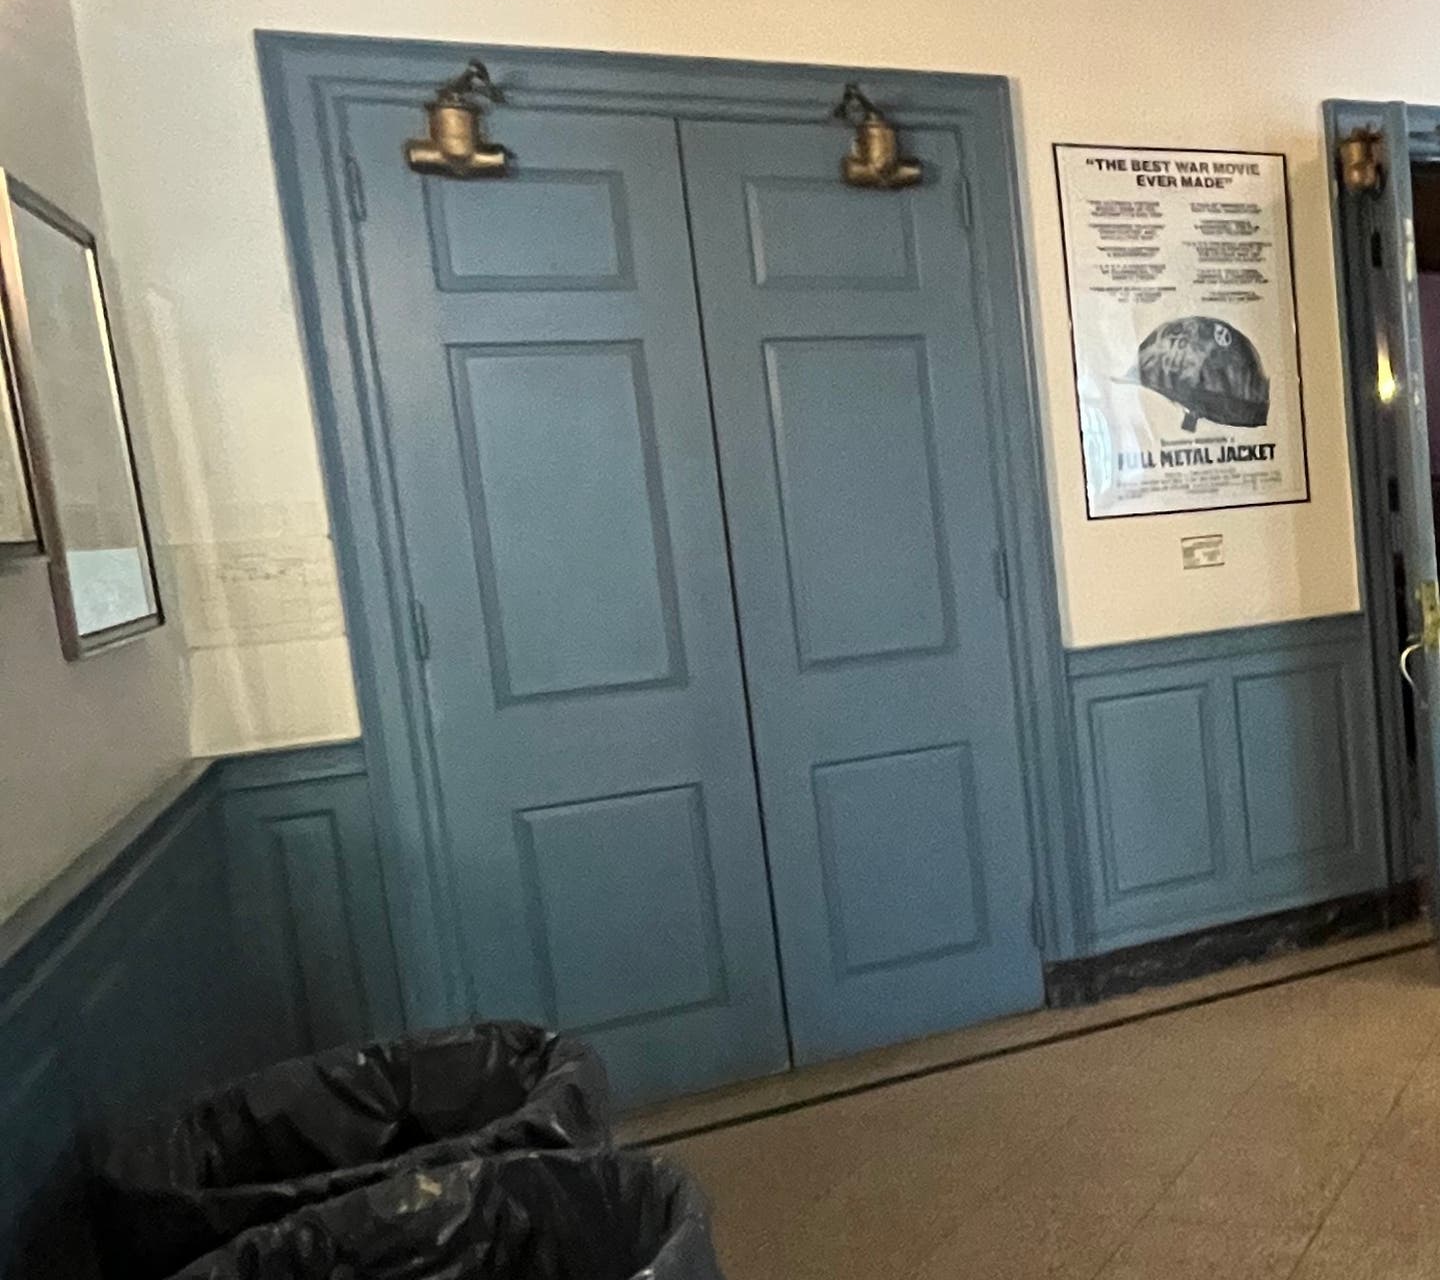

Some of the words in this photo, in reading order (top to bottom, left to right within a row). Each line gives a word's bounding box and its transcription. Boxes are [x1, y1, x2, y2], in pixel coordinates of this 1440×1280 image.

[1131, 160, 1171, 173] BEST
[1174, 162, 1210, 174] WAR
[1212, 163, 1261, 176] MOVIE
[1136, 175, 1177, 188] EVER
[1160, 447, 1213, 468] METAL
[1217, 443, 1277, 463] JACKET
